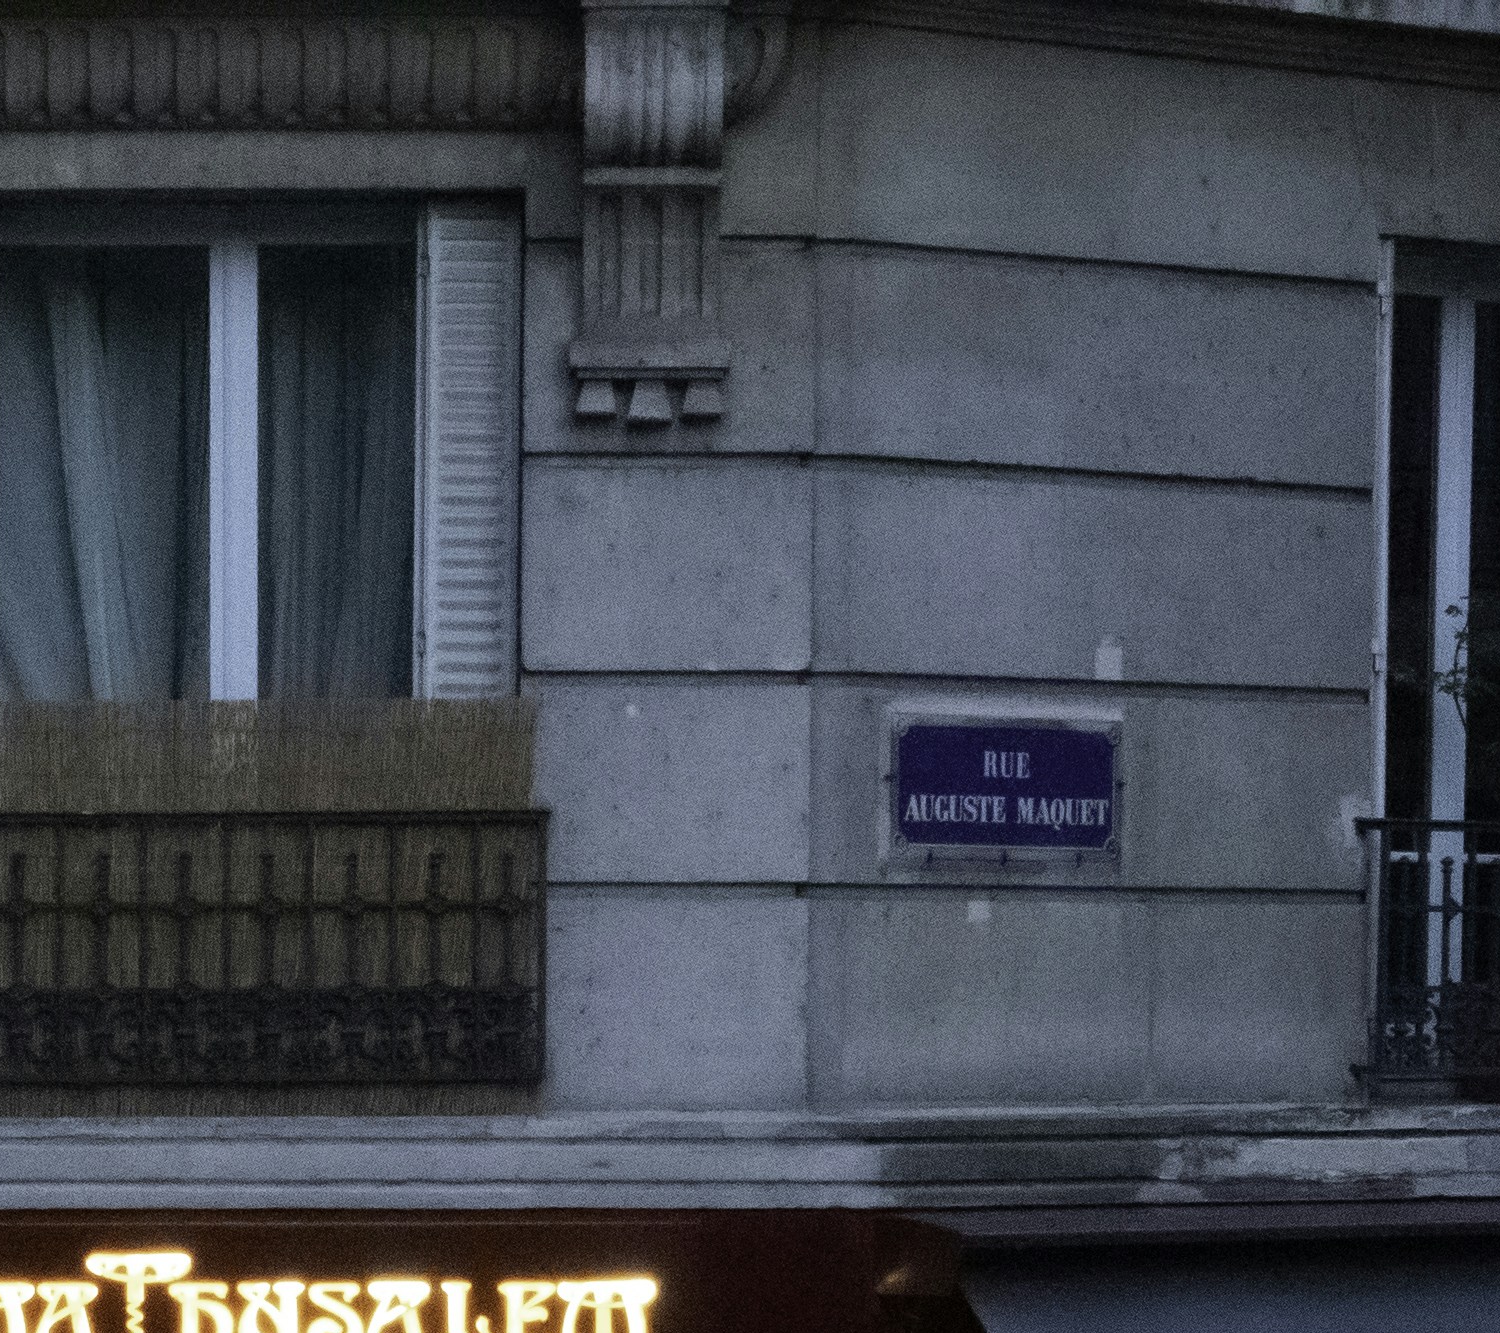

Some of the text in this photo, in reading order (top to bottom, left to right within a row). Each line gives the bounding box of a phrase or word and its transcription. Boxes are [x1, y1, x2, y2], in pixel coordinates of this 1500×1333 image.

[983, 750, 1031, 779] RUE
[904, 794, 1110, 831] AUGUSTE MAQUET
